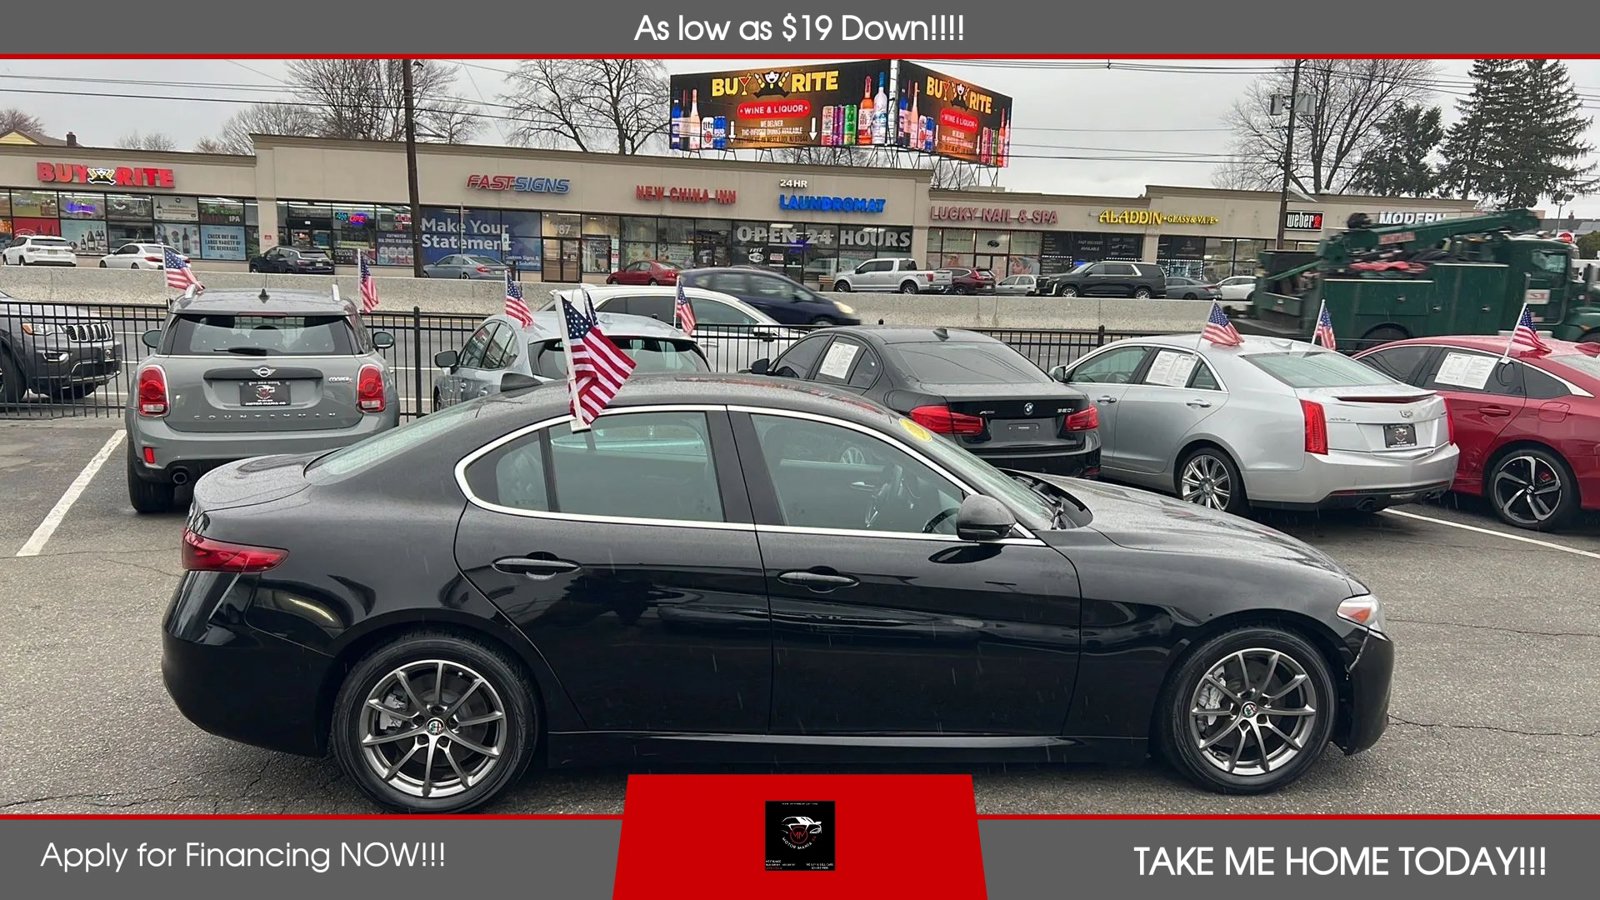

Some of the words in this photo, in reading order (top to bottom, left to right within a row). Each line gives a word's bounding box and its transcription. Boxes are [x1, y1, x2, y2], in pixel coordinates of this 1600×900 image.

[791, 70, 839, 93] RITE
[743, 107, 764, 115] WINE
[766, 105, 772, 114] &
[773, 104, 804, 113] LIQUOR
[969, 91, 993, 114] RITE
[37, 162, 88, 183] BUY
[116, 167, 175, 188] RITE
[636, 185, 664, 200] NEW
[669, 187, 709, 203] CHINA
[715, 190, 736, 204] INN
[779, 194, 886, 213] LAUNDROMAT
[931, 206, 978, 221] LUCKY
[982, 207, 1012, 223] NAIL
[1018, 209, 1028, 224] &
[1032, 210, 1058, 224] SPA
[1100, 210, 1162, 225] ALADDIN
[1287, 212, 1314, 228] weber
[1379, 211, 1446, 224] MODERN
[421, 217, 466, 232] Make
[470, 219, 509, 234] Your
[737, 226, 797, 244] OPEN
[806, 230, 832, 245] 24
[840, 231, 910, 247] HOURS
